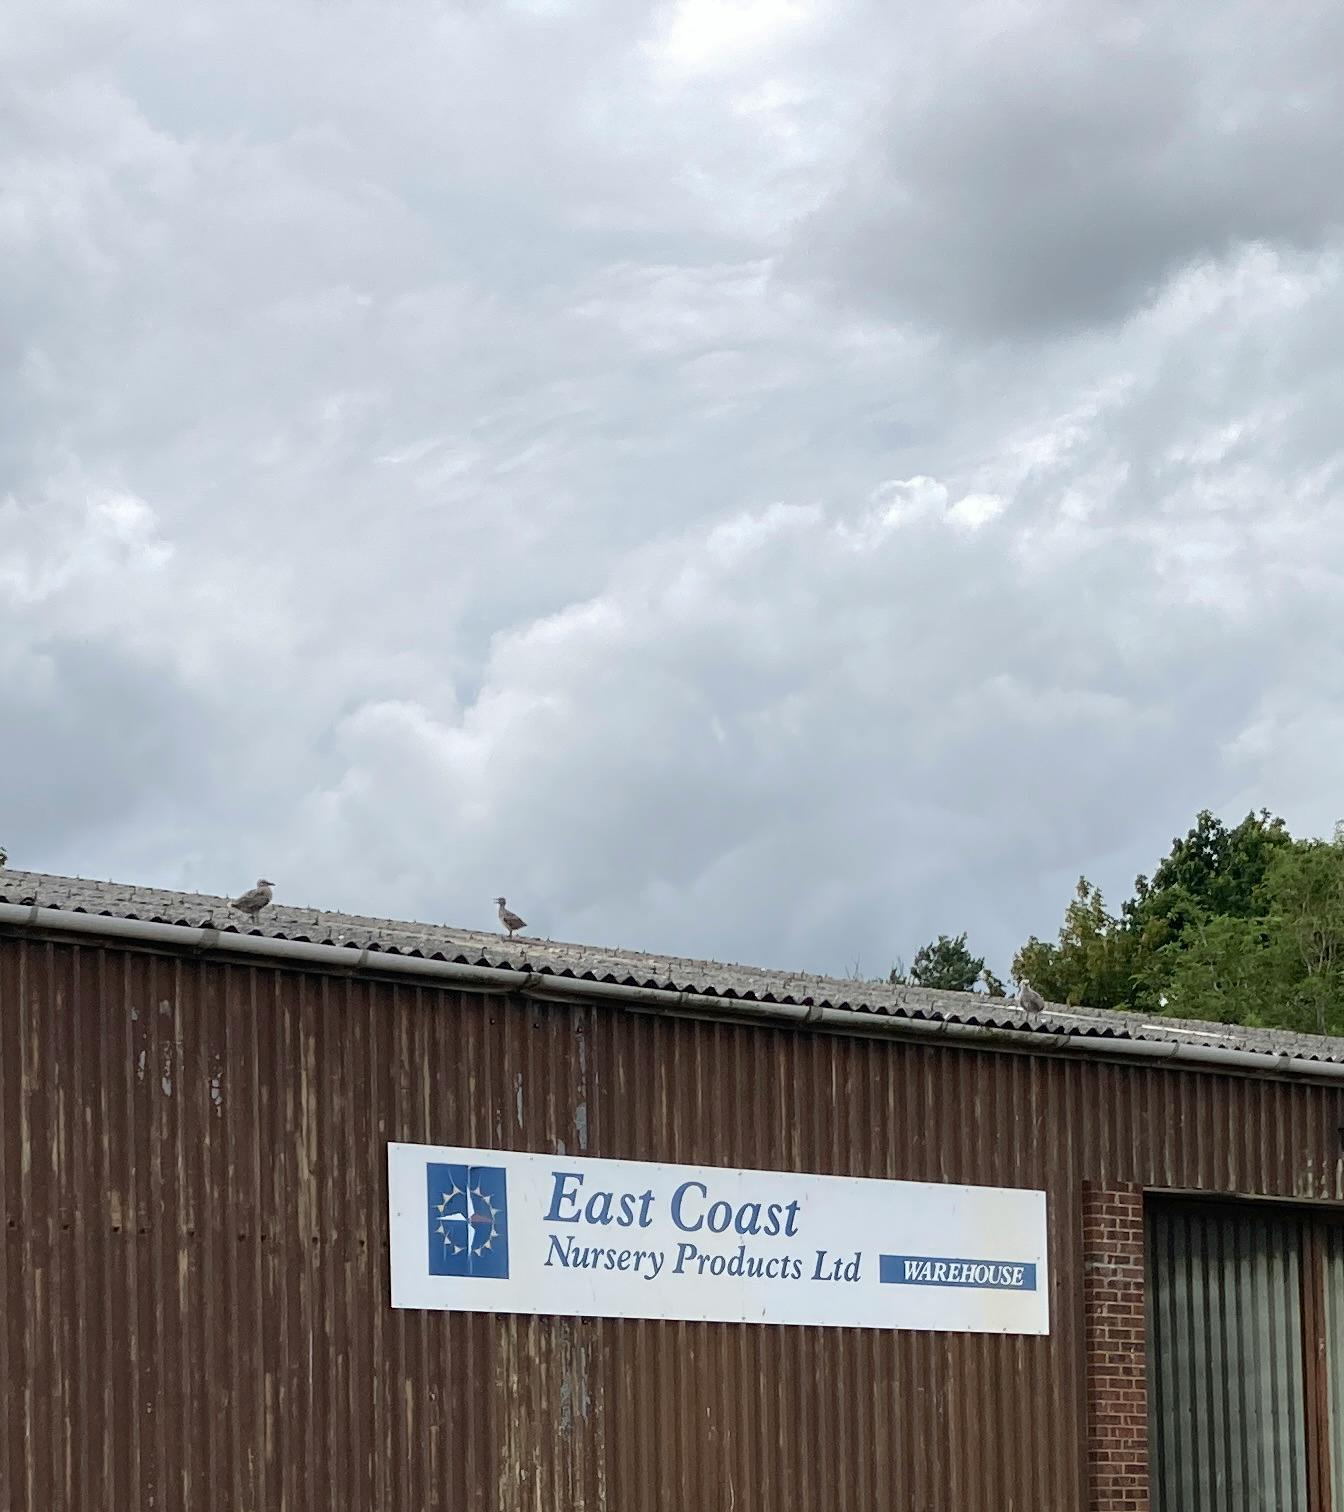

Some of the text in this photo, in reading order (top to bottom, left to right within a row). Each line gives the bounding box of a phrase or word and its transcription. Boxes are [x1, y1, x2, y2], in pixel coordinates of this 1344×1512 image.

[542, 1171, 801, 1238] East Coast
[543, 1234, 862, 1283] Nursery Products Ltd
[902, 1259, 1025, 1287] WAREHOUSE
